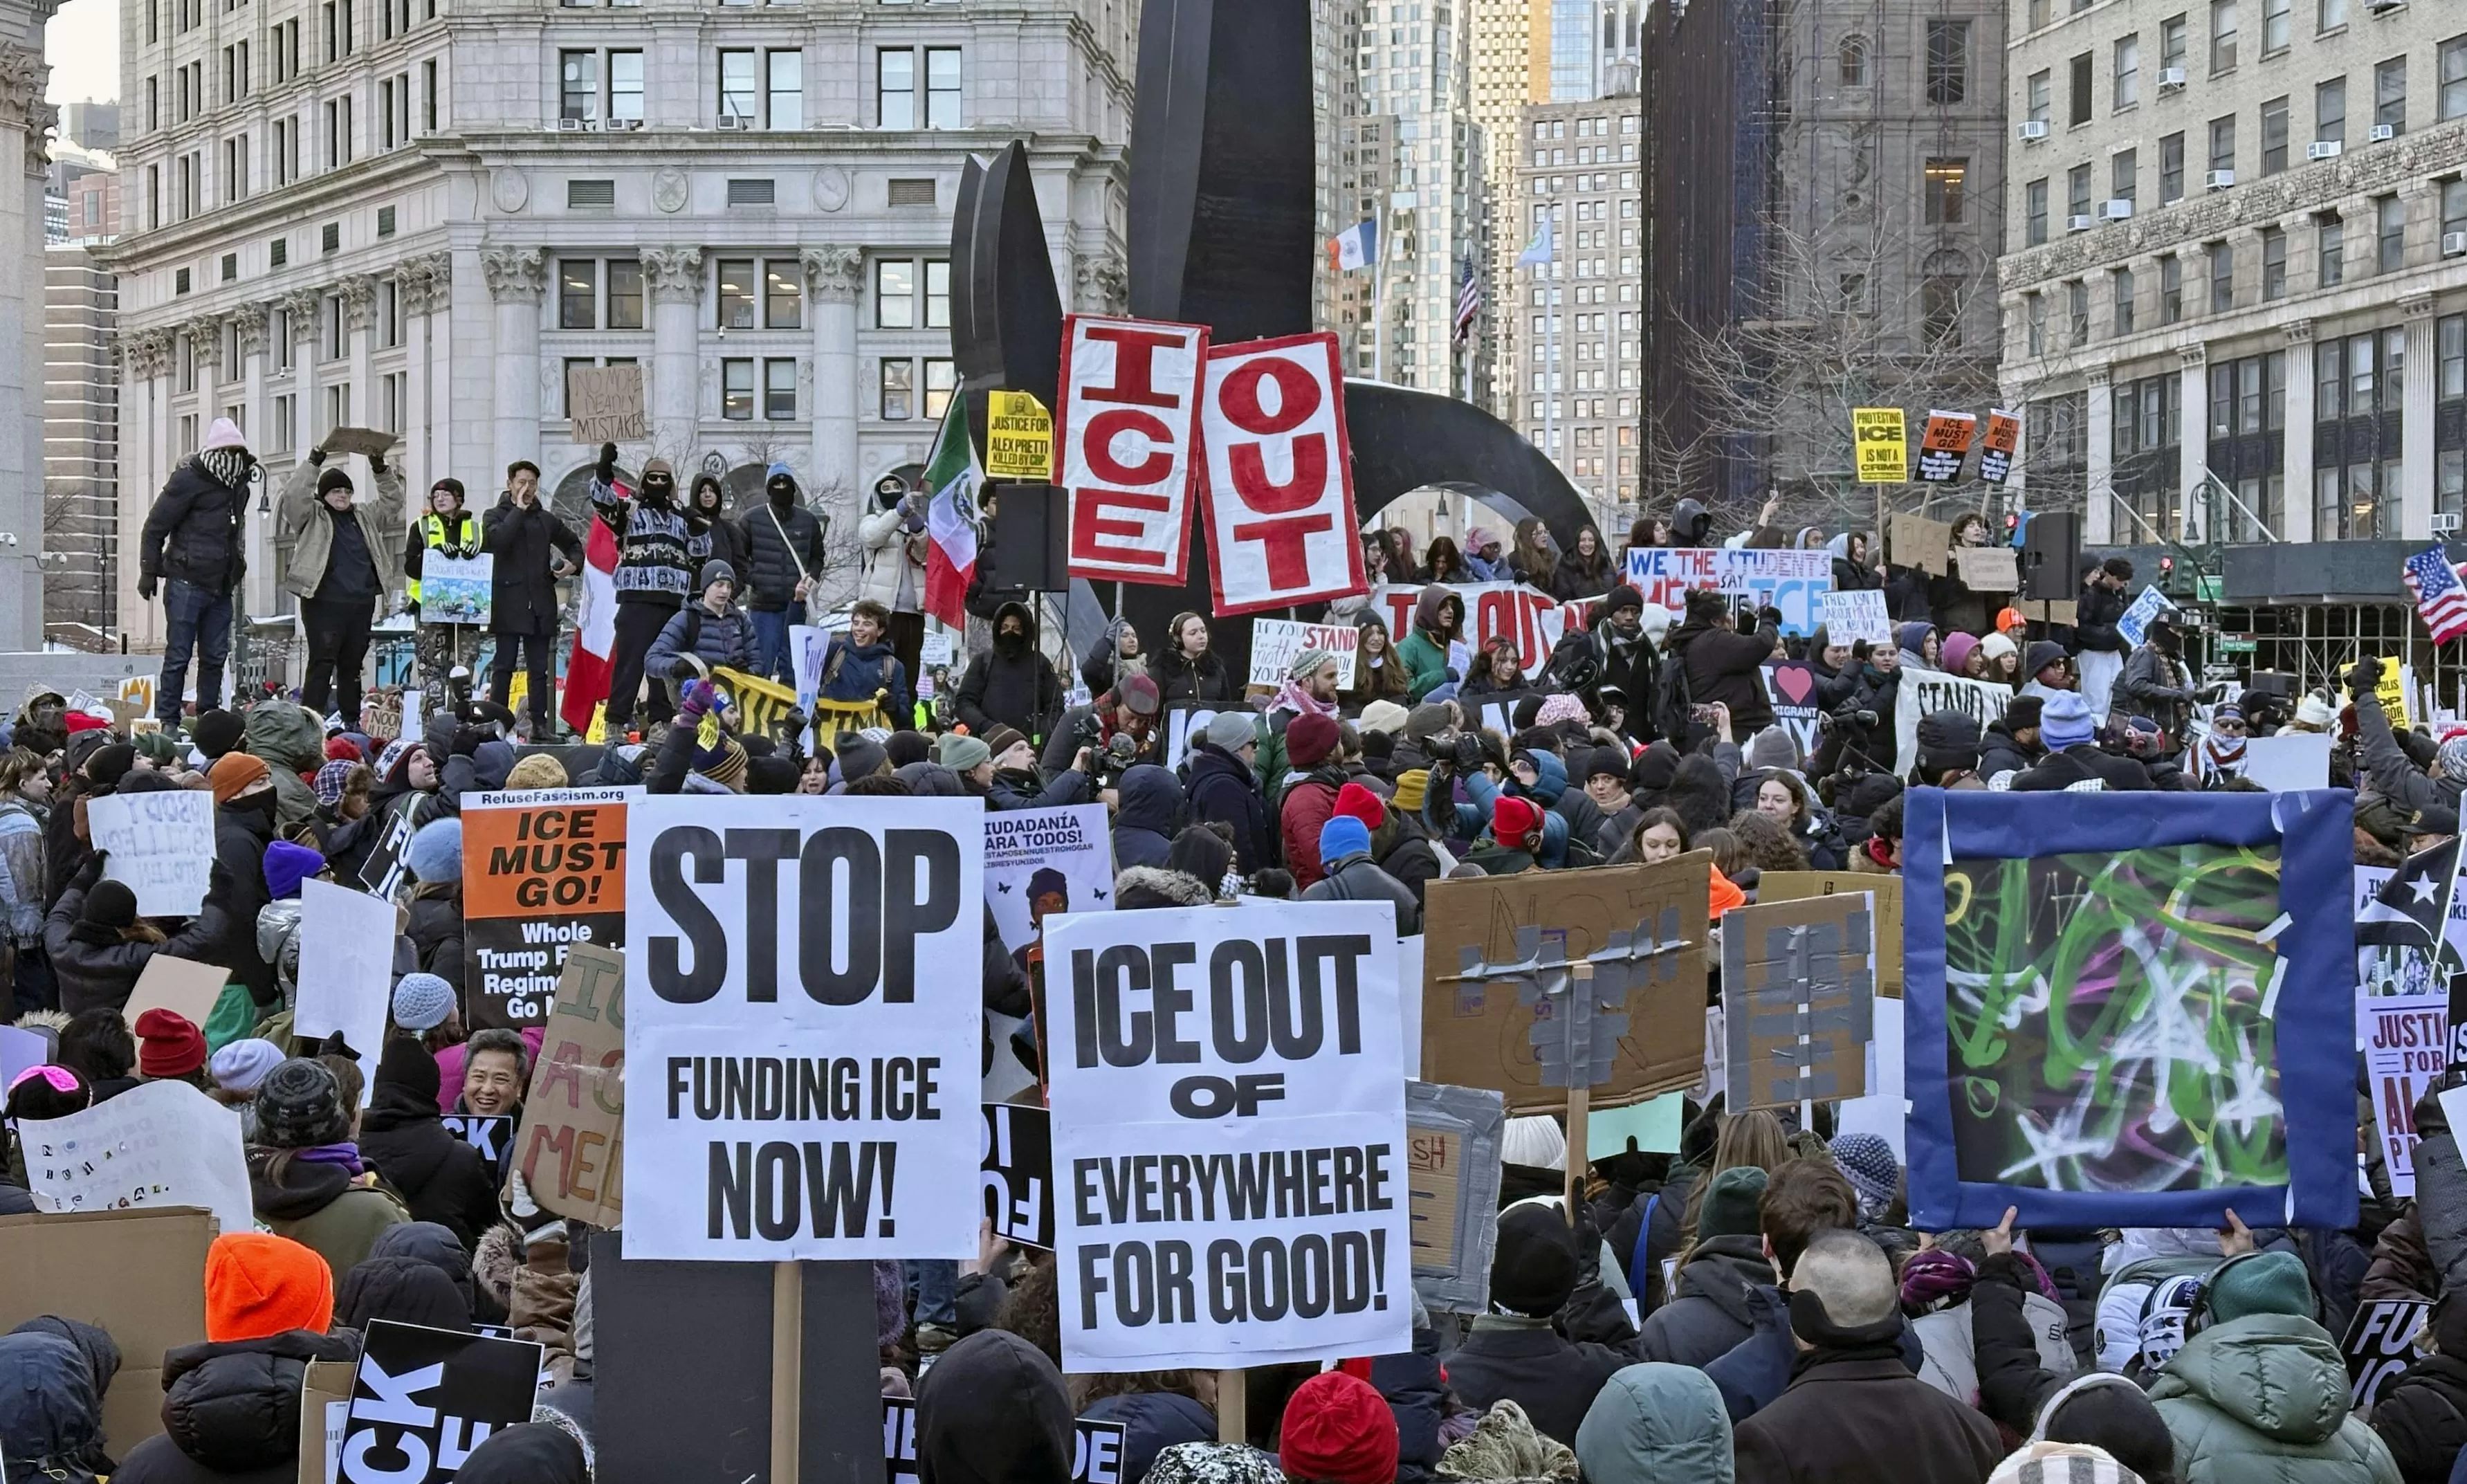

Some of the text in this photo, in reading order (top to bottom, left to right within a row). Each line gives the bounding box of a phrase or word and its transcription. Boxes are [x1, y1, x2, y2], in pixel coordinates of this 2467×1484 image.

[576, 367, 642, 396] NO MORE
[585, 393, 634, 415] DEADLY
[1857, 412, 1902, 424] PROTESTING
[991, 416, 1049, 432] JUSTICE FOR
[1858, 425, 1902, 441] ICE
[1933, 428, 1969, 439] MUST
[1943, 419, 1963, 428] ICE
[991, 437, 1047, 454] ALEX PRETTI
[1072, 327, 1186, 567] ICE
[1866, 448, 1898, 462] IS NOT A
[1937, 439, 1961, 448] GO!
[993, 452, 1017, 464] KILLED
[1019, 454, 1029, 465] BY
[1219, 357, 1332, 591] OUT
[1630, 551, 1830, 576] WE THE STUDENTS
[1905, 544, 1935, 567] IE
[1721, 574, 1744, 589] SAY
[1824, 594, 1846, 606] THIS
[2143, 589, 2164, 611] ICE
[1277, 622, 1306, 637] YOU
[1303, 626, 1357, 651] STAND
[1478, 591, 1555, 670] OUT
[1254, 639, 1299, 668] nothi
[124, 665, 133, 674] 40
[1771, 704, 1817, 718] MIGRANT
[482, 790, 624, 805] RefuseFascism.org
[517, 809, 597, 841] ICE
[984, 812, 1079, 835] IUDADANÍA
[386, 818, 414, 867] FU
[985, 830, 1082, 851] ARA TODOS!
[488, 841, 627, 876] MUST
[516, 875, 602, 908] GO!
[648, 826, 960, 1005] STOP
[521, 922, 592, 944] Whole
[477, 949, 548, 970] Trump
[556, 954, 625, 1030] IC
[1072, 942, 1201, 1069] ICE
[1209, 935, 1371, 1065] OUT
[507, 999, 538, 1018] Go
[2373, 1013, 2447, 1049] JUSTI
[2403, 1050, 2445, 1072] FOR
[666, 1057, 941, 1121] FUNDING ICE
[1170, 1073, 1285, 1119] OF
[442, 1117, 497, 1161] CK
[523, 1124, 623, 1211] MEL
[707, 1142, 897, 1241] NOW!
[1073, 1143, 1393, 1227] EVERYWHERE
[983, 1170, 1040, 1242] FU
[1078, 1229, 1388, 1330] FOR GOOD!
[2351, 1303, 2431, 1356] FU
[2351, 1358, 2408, 1409] IC
[342, 1352, 445, 1484] CK
